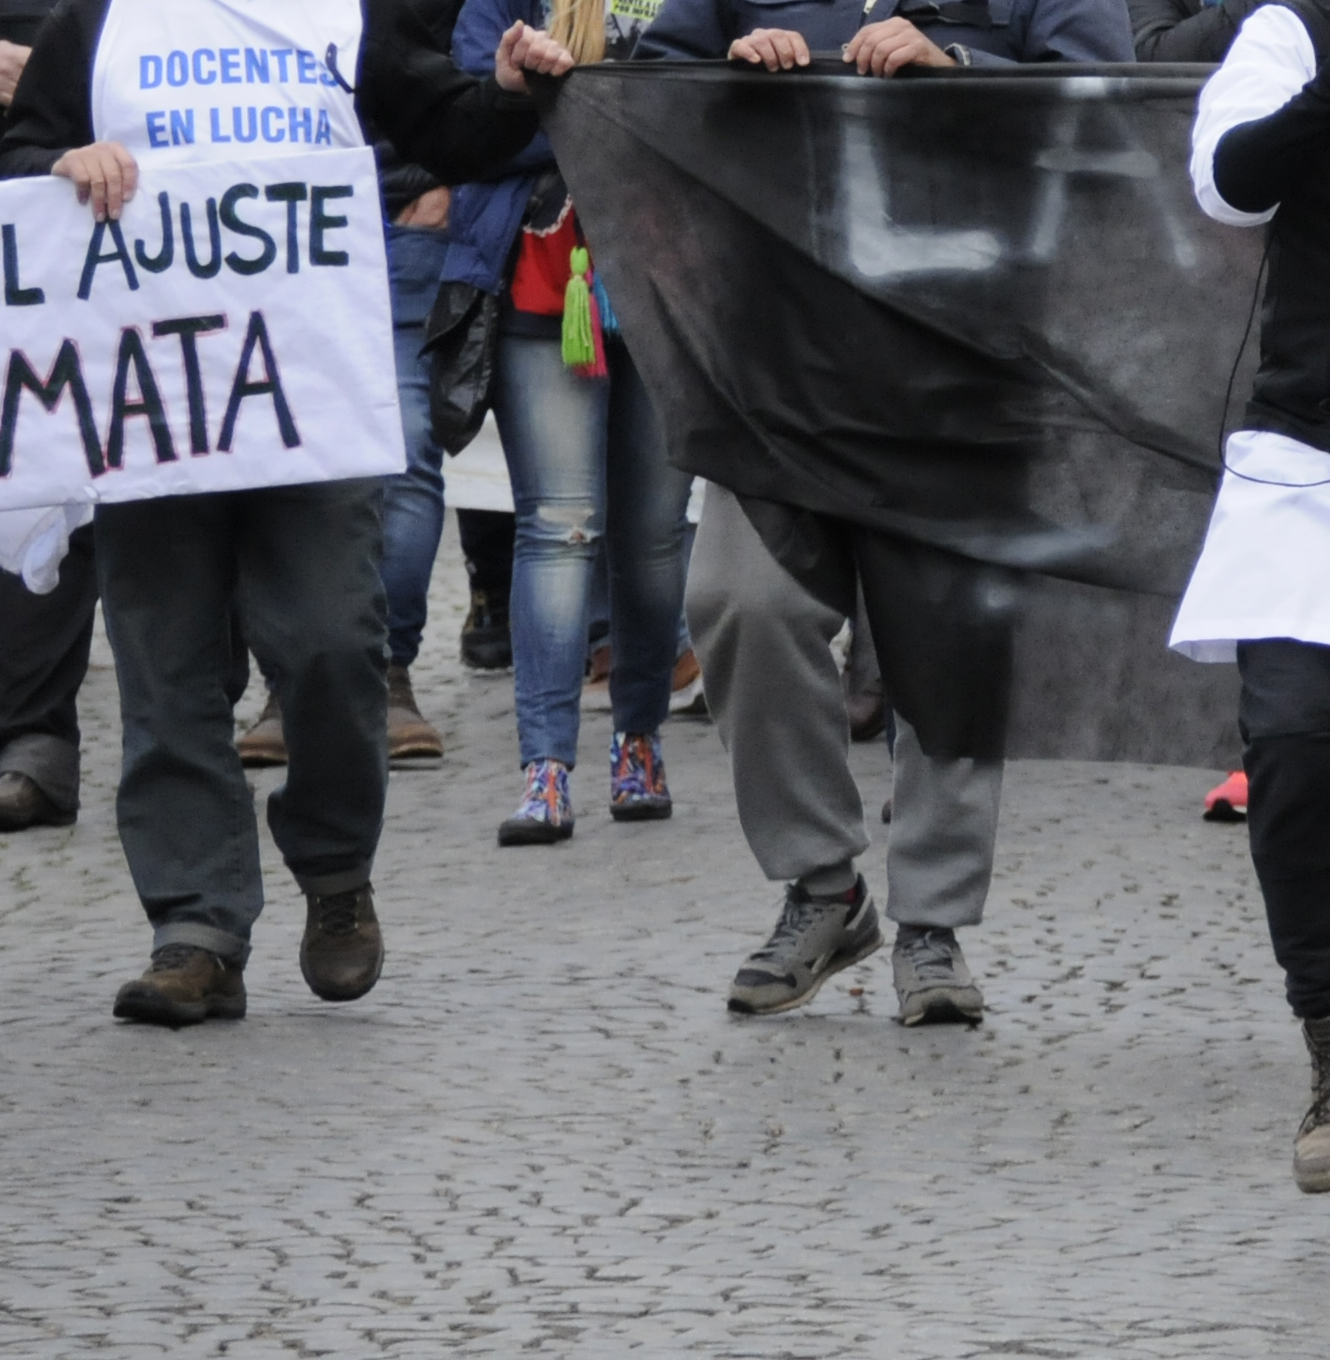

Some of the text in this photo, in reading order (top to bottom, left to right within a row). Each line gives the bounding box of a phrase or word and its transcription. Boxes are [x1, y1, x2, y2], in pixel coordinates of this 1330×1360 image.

[146, 105, 332, 149] EN LUCHA
[838, 77, 1200, 277] LA
[76, 181, 354, 301] AJUSTE
[0, 310, 302, 479] MATA
